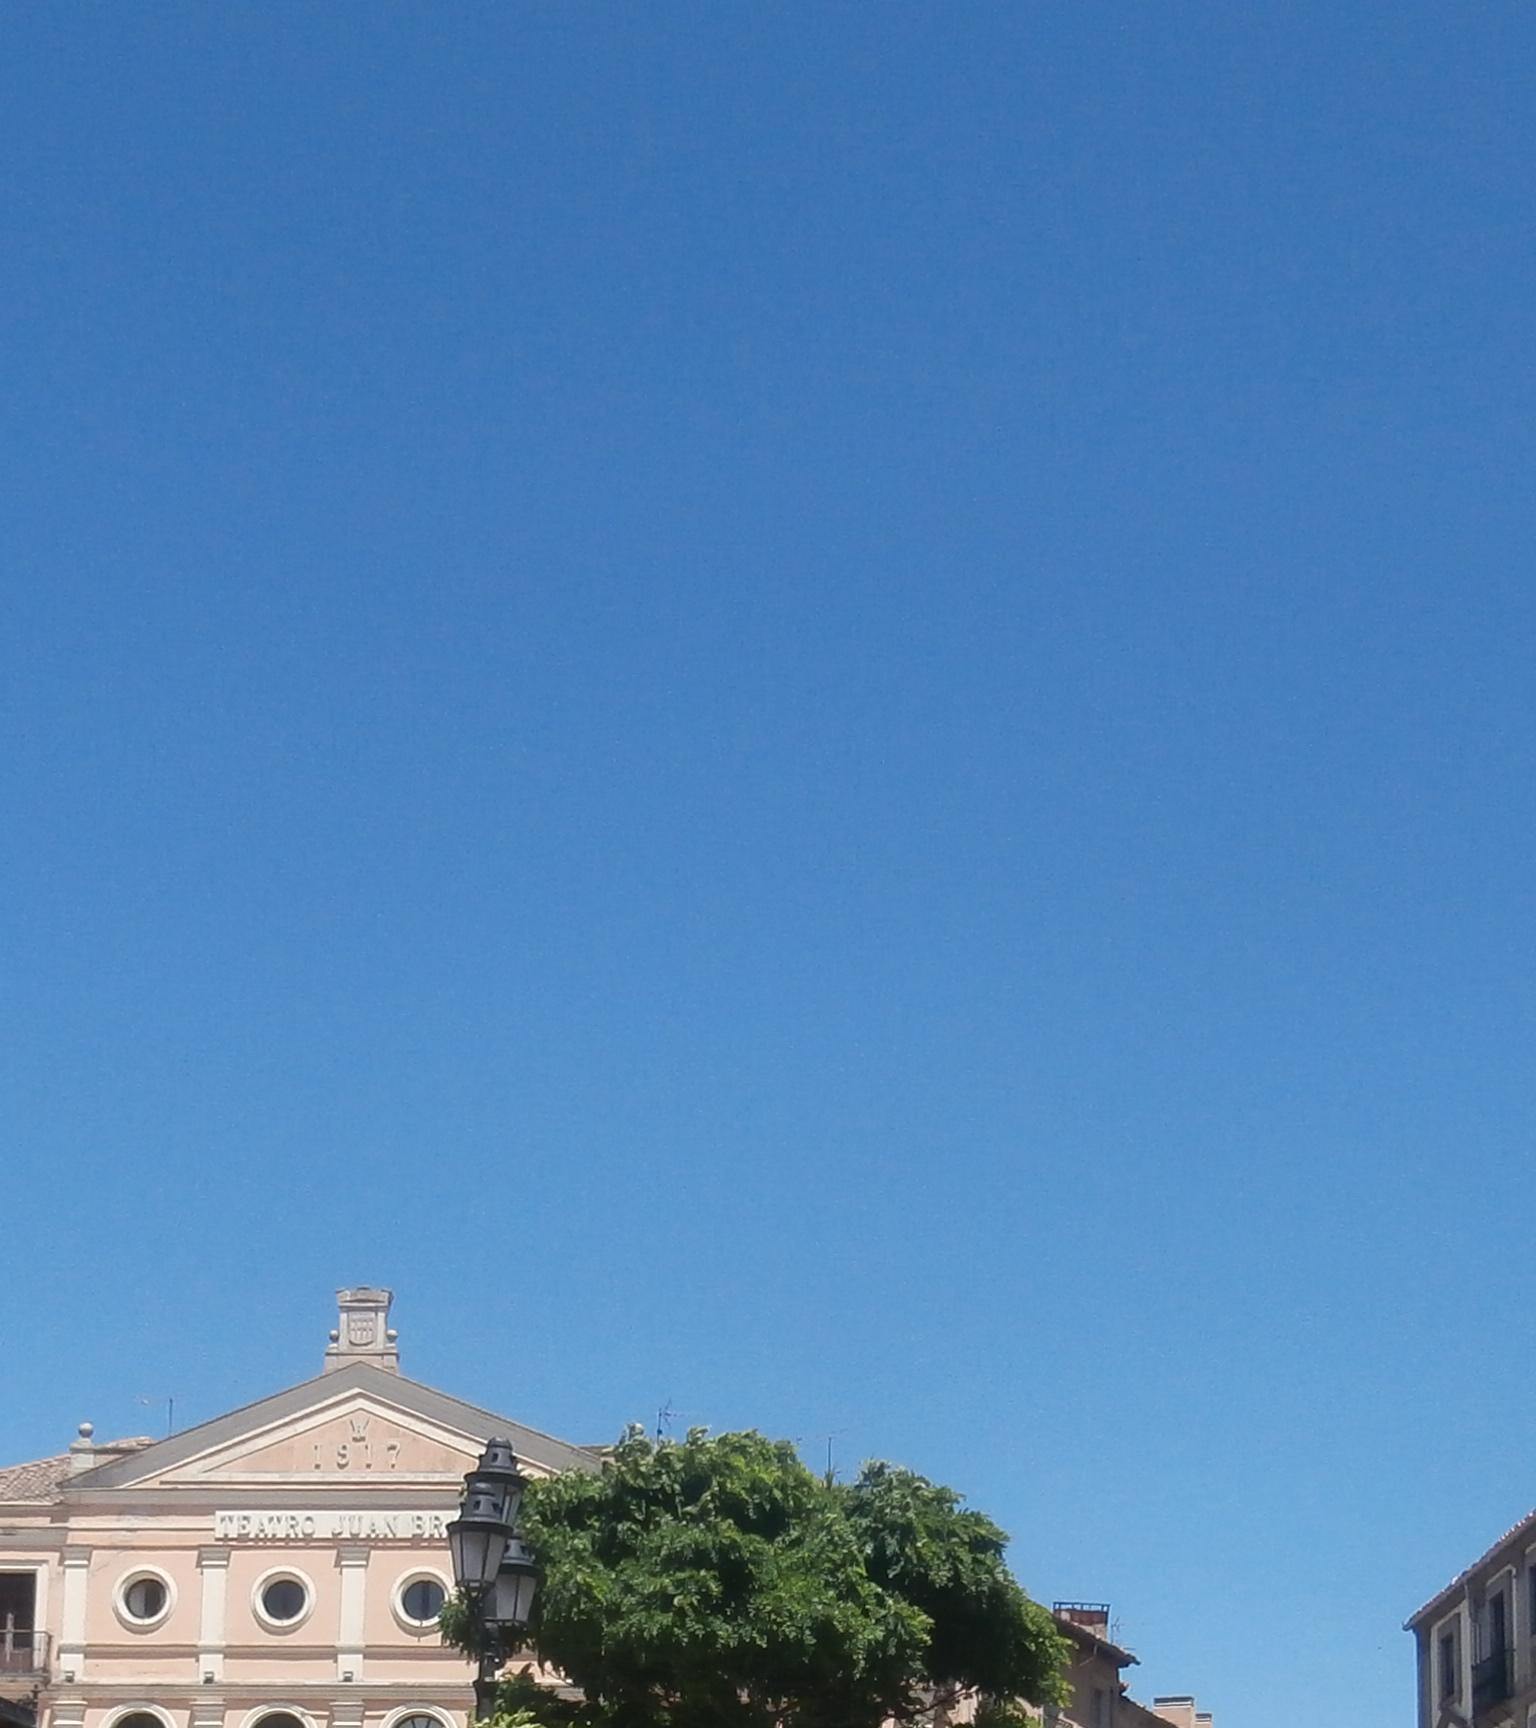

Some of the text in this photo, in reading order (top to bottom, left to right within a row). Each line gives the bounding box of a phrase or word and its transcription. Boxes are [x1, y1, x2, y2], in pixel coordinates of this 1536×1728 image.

[313, 1443, 402, 1471] 1917
[219, 1513, 448, 1539] TEATRO JUAN BR
